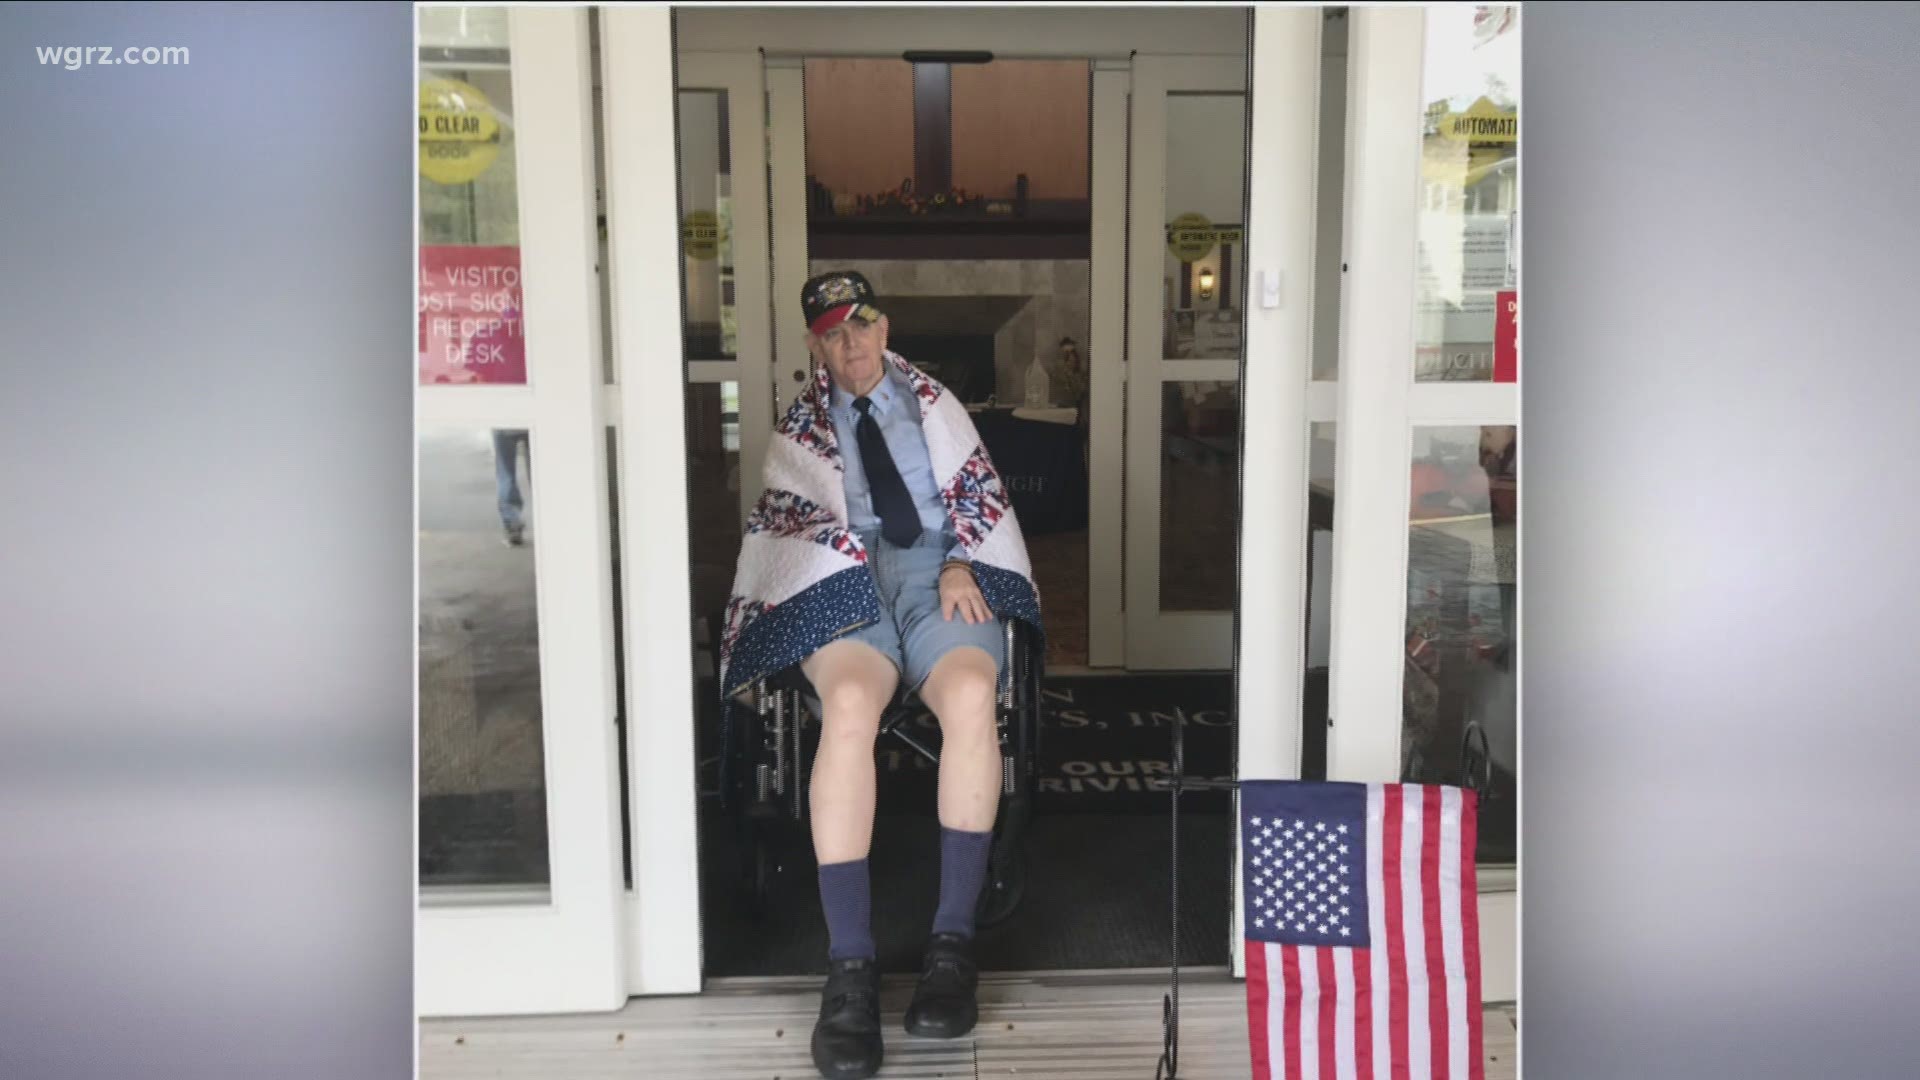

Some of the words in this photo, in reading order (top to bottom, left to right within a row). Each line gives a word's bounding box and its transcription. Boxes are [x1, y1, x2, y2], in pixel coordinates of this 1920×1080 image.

[435, 115, 480, 134] CLEAR
[469, 291, 520, 313] SIGN
[445, 342, 505, 364] DESK
[1061, 760, 1174, 776] OUR
